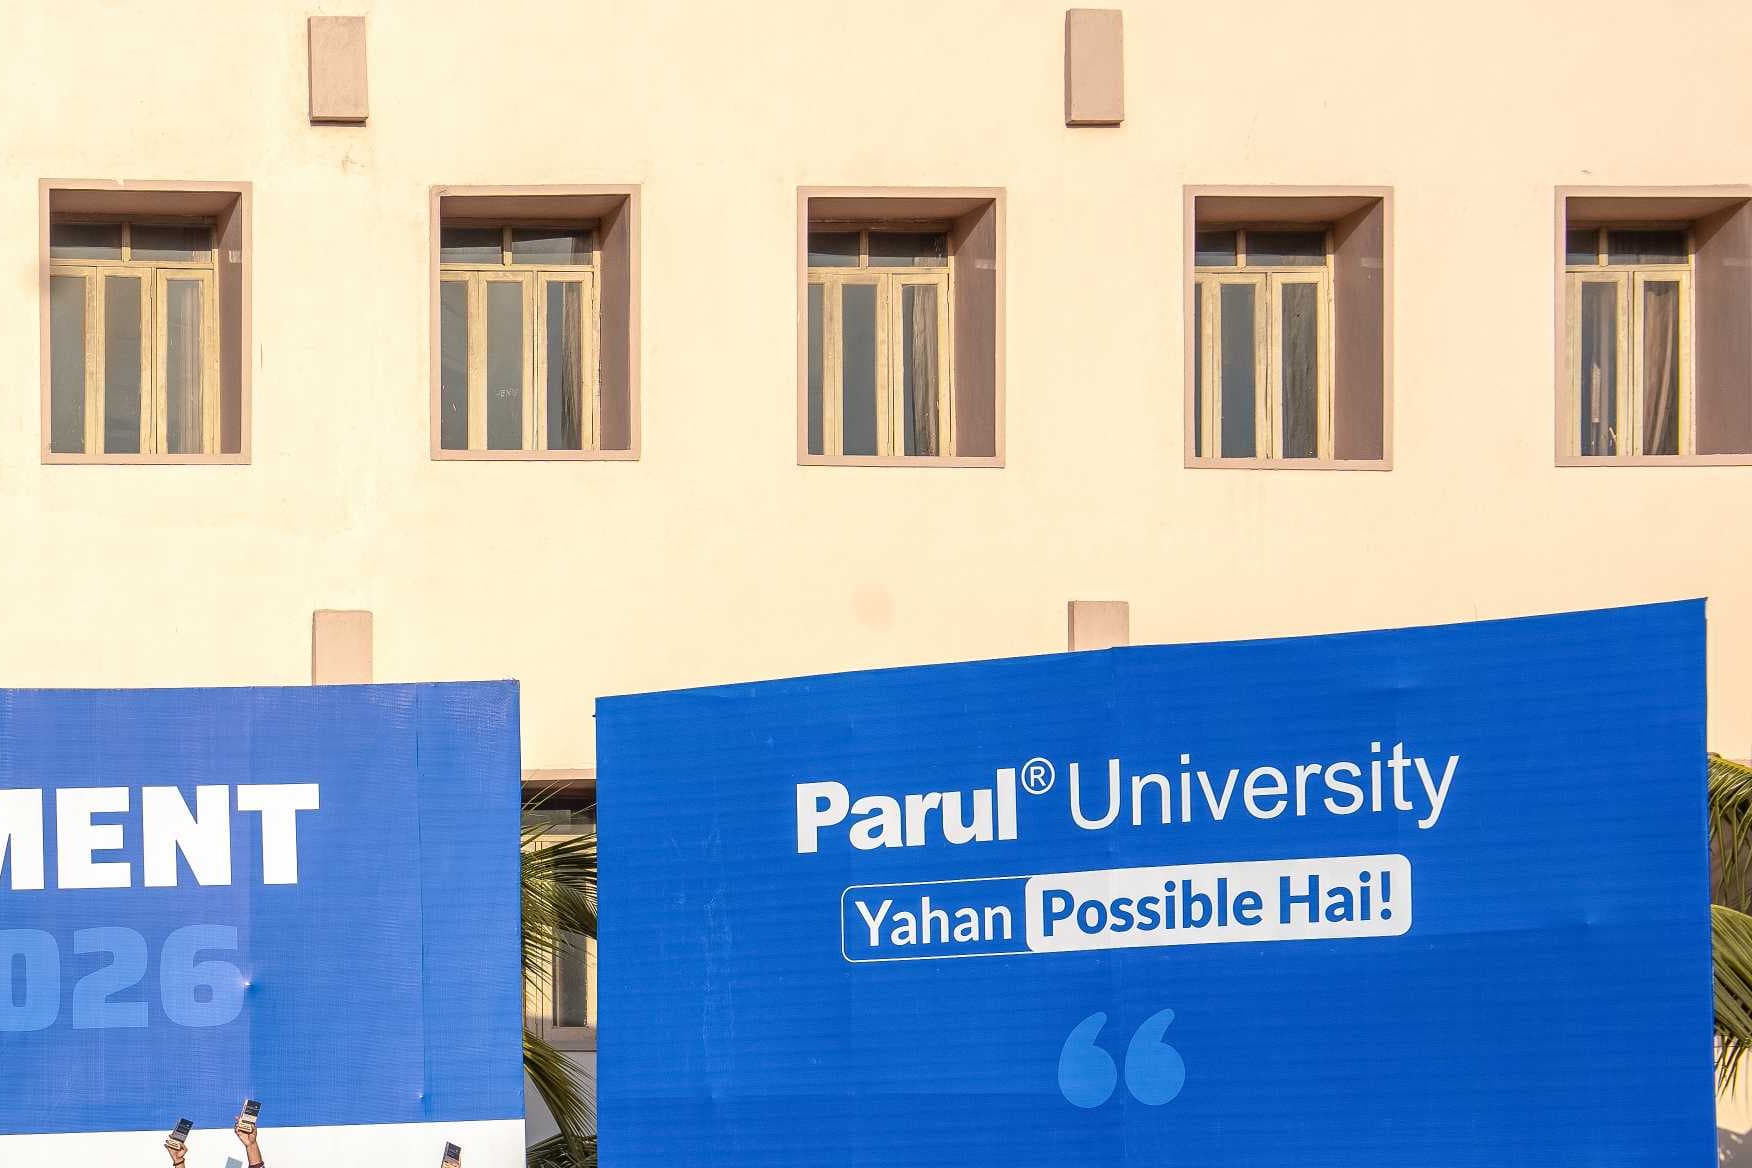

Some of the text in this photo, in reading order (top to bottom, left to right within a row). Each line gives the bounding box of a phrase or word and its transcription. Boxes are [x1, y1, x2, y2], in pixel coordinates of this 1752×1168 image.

[1069, 741, 1460, 830] University
[855, 871, 1393, 947] Yahan Possible Hai!
